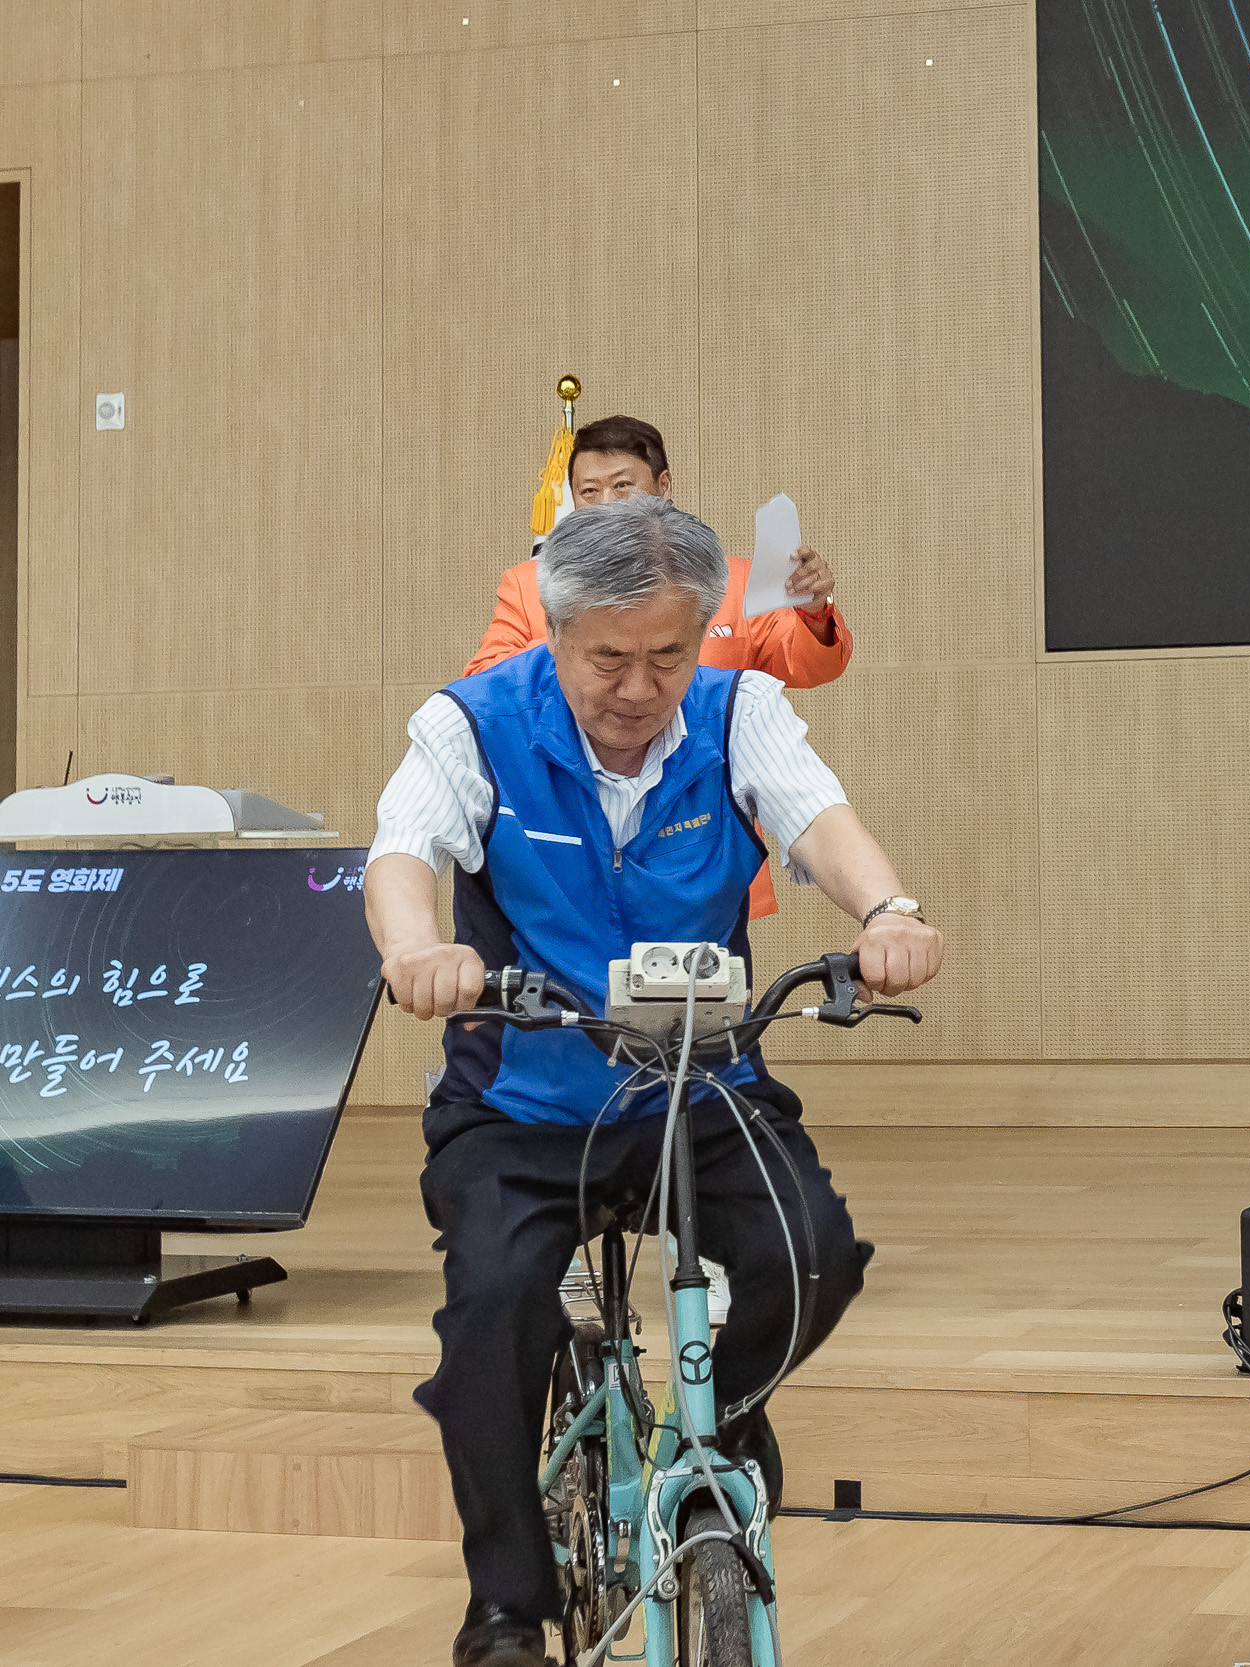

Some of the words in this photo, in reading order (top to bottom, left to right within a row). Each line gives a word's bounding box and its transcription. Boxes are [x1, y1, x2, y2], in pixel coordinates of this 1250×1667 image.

[47, 867, 125, 893] 영화제
[102, 959, 208, 1007] 힘으로
[0, 1034, 124, 1098] 만들어
[138, 1039, 250, 1092] 주세요
